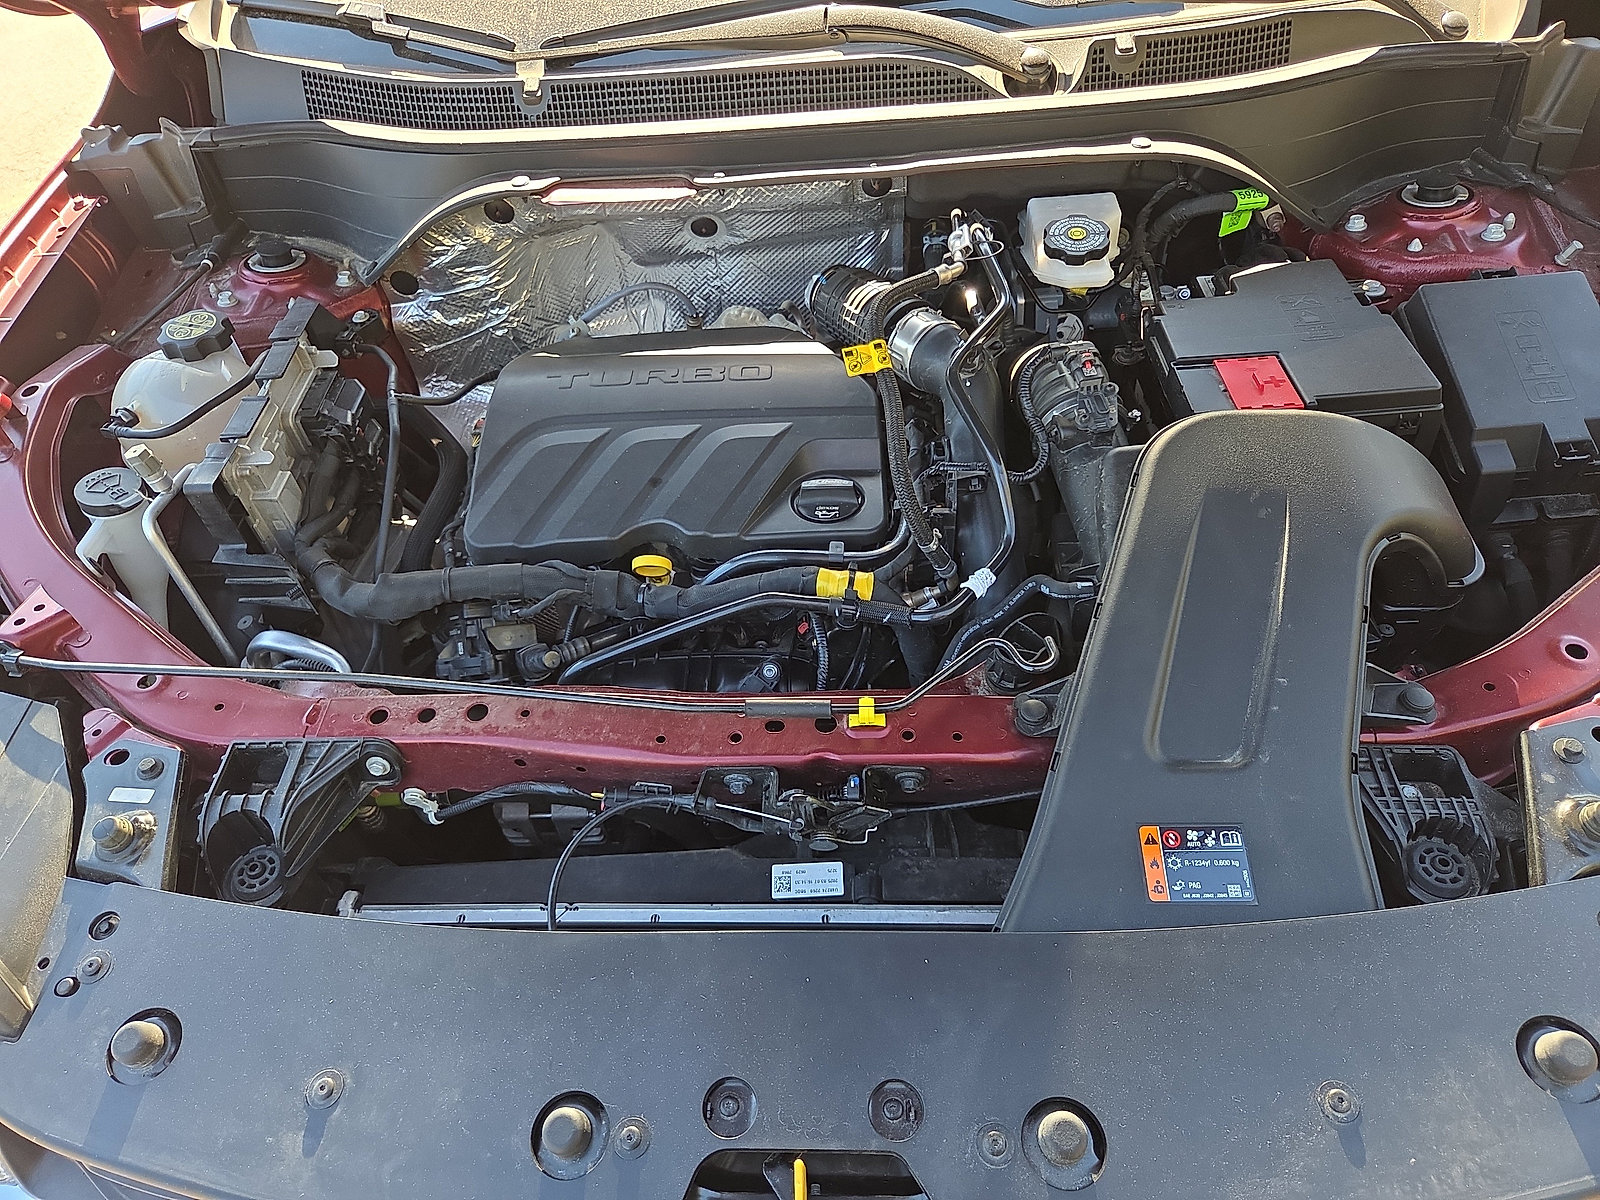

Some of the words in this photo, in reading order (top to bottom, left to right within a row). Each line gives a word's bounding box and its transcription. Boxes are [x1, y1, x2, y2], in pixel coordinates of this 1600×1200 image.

[1238, 189, 1264, 200] 5925
[547, 364, 773, 390] TURBO
[1184, 859, 1211, 868] R-1234yf
[1213, 859, 1231, 867] 0.600
[1231, 859, 1240, 868] kg
[1188, 881, 1202, 889] PAG
